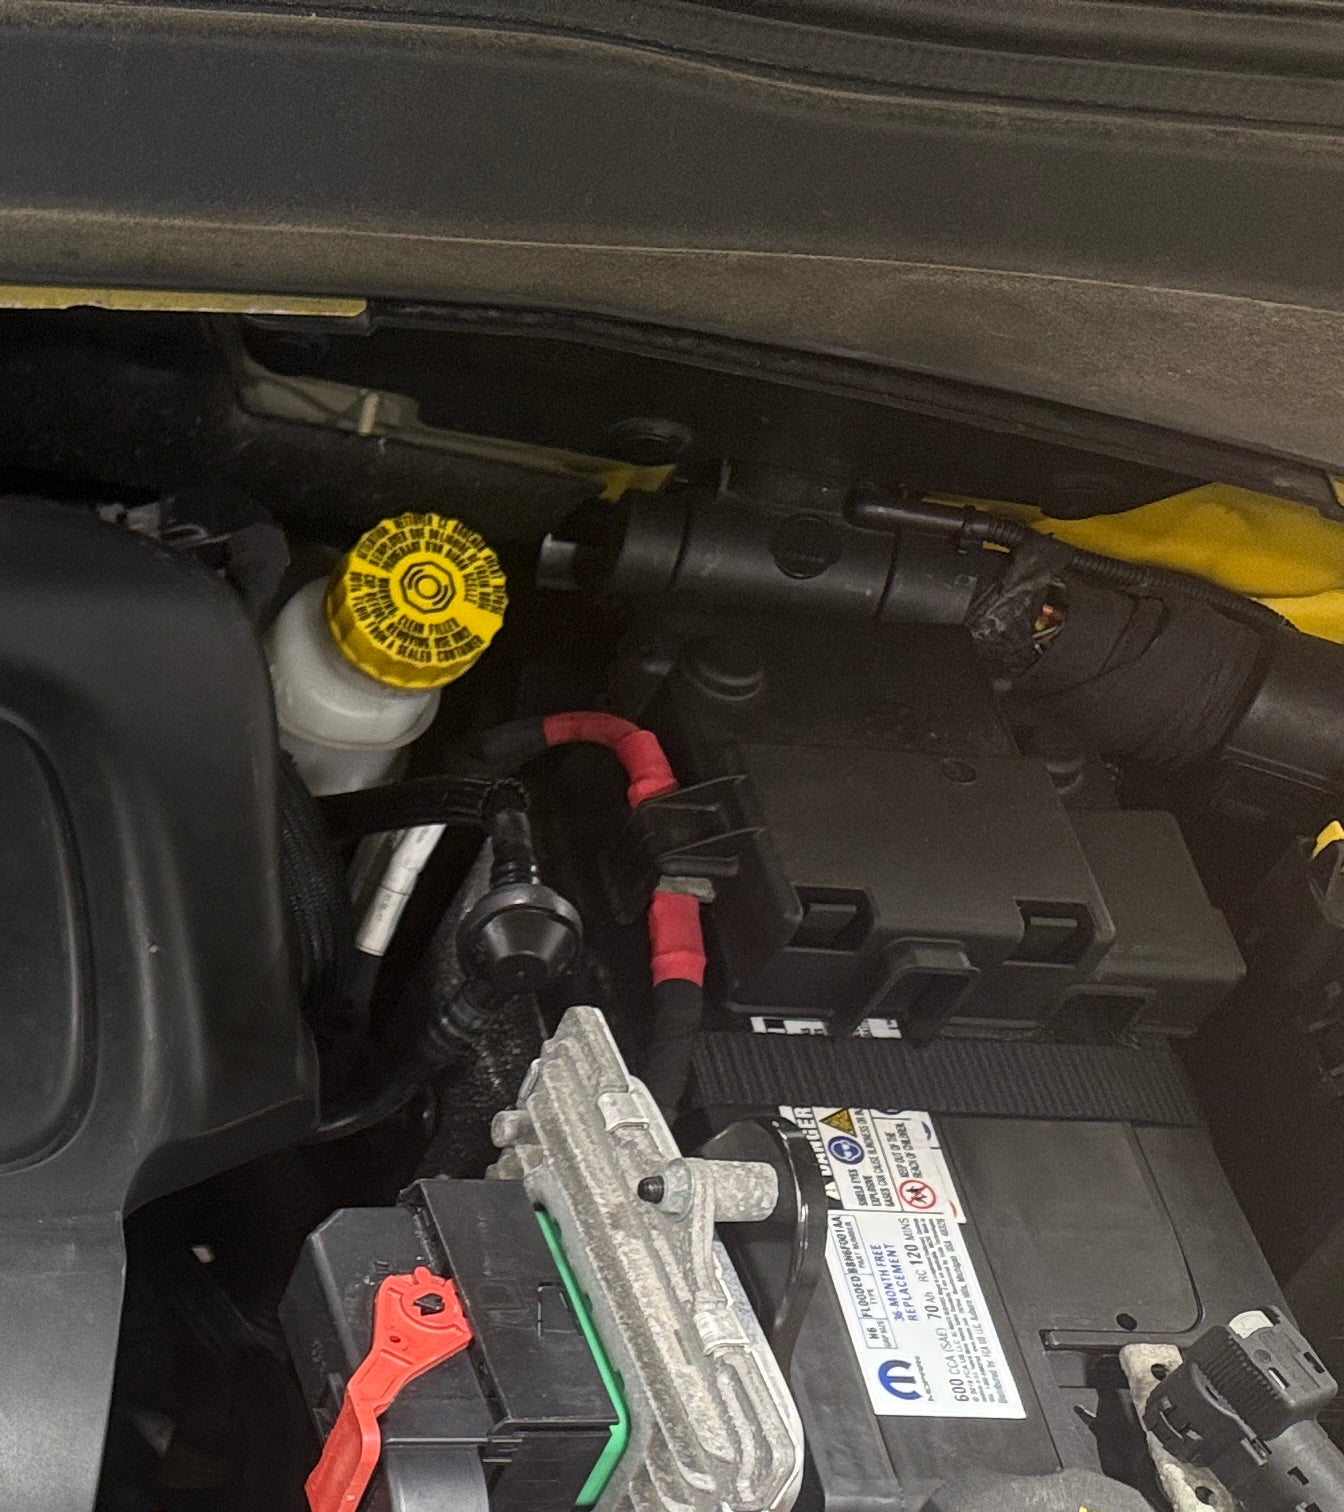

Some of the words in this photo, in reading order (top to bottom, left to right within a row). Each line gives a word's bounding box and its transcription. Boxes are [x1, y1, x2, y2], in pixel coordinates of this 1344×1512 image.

[898, 1217, 915, 1240] MINS
[855, 1252, 865, 1268] PART
[870, 1244, 886, 1266] FREE
[904, 1244, 923, 1265] 120
[883, 1242, 918, 1321] REPLACEMENT
[915, 1269, 929, 1282] RC
[850, 1275, 872, 1317] FLOODED
[867, 1288, 878, 1304] TYPE
[924, 1305, 941, 1319] 70
[935, 1327, 953, 1351] (SAE)
[944, 1355, 960, 1374] CCA
[948, 1378, 970, 1401] 600
